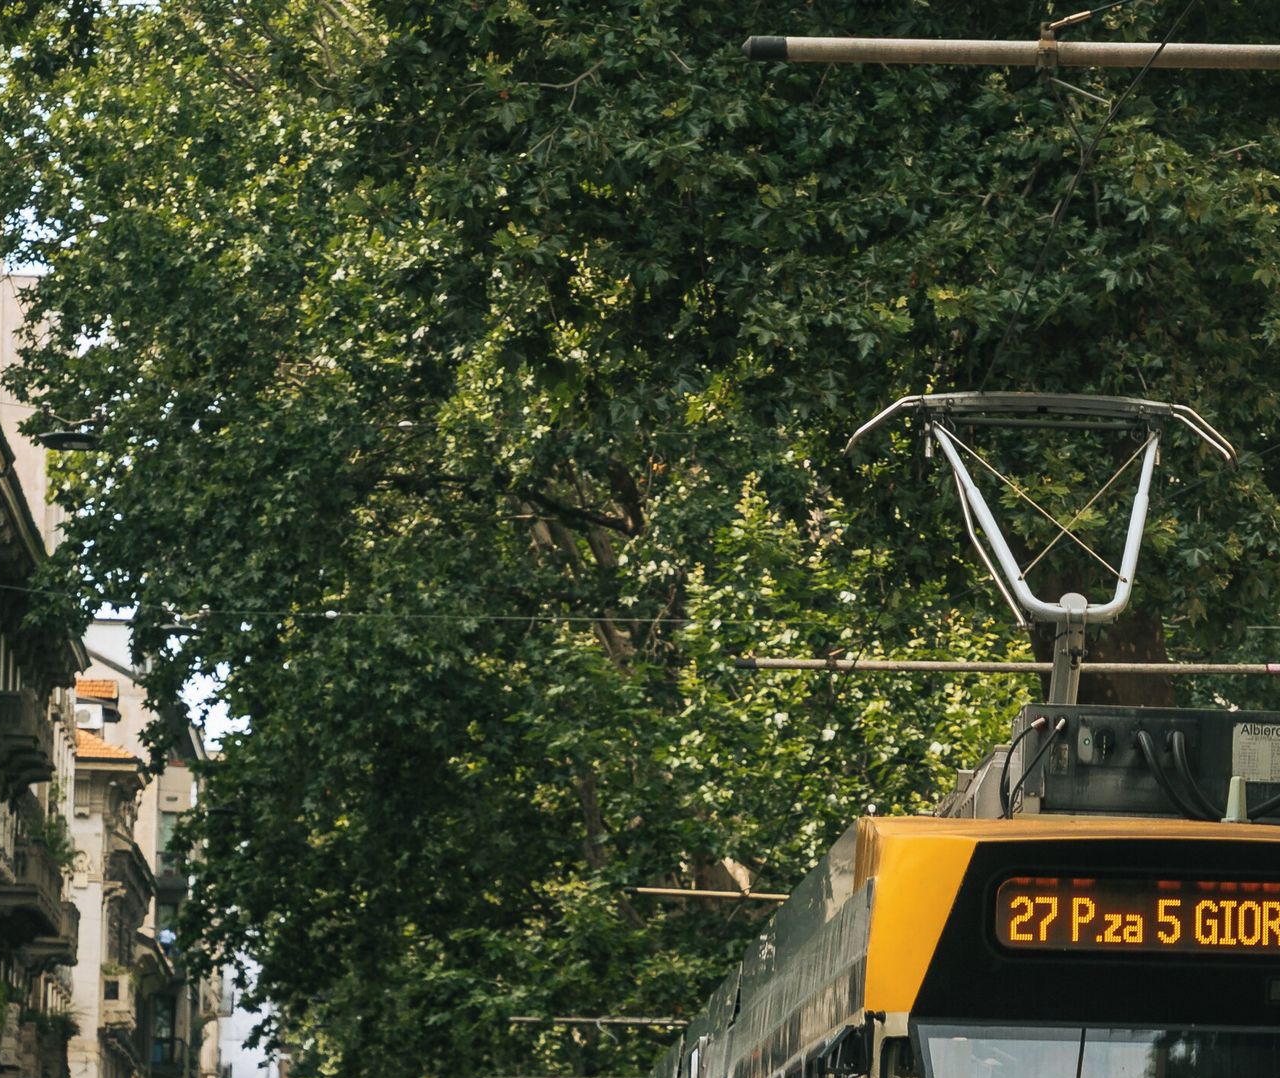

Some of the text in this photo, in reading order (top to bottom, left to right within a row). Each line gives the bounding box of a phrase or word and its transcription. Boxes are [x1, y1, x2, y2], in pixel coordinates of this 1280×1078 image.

[1010, 896, 1058, 942] 27
[1072, 897, 1143, 943] P.za
[1157, 899, 1181, 944] 5
